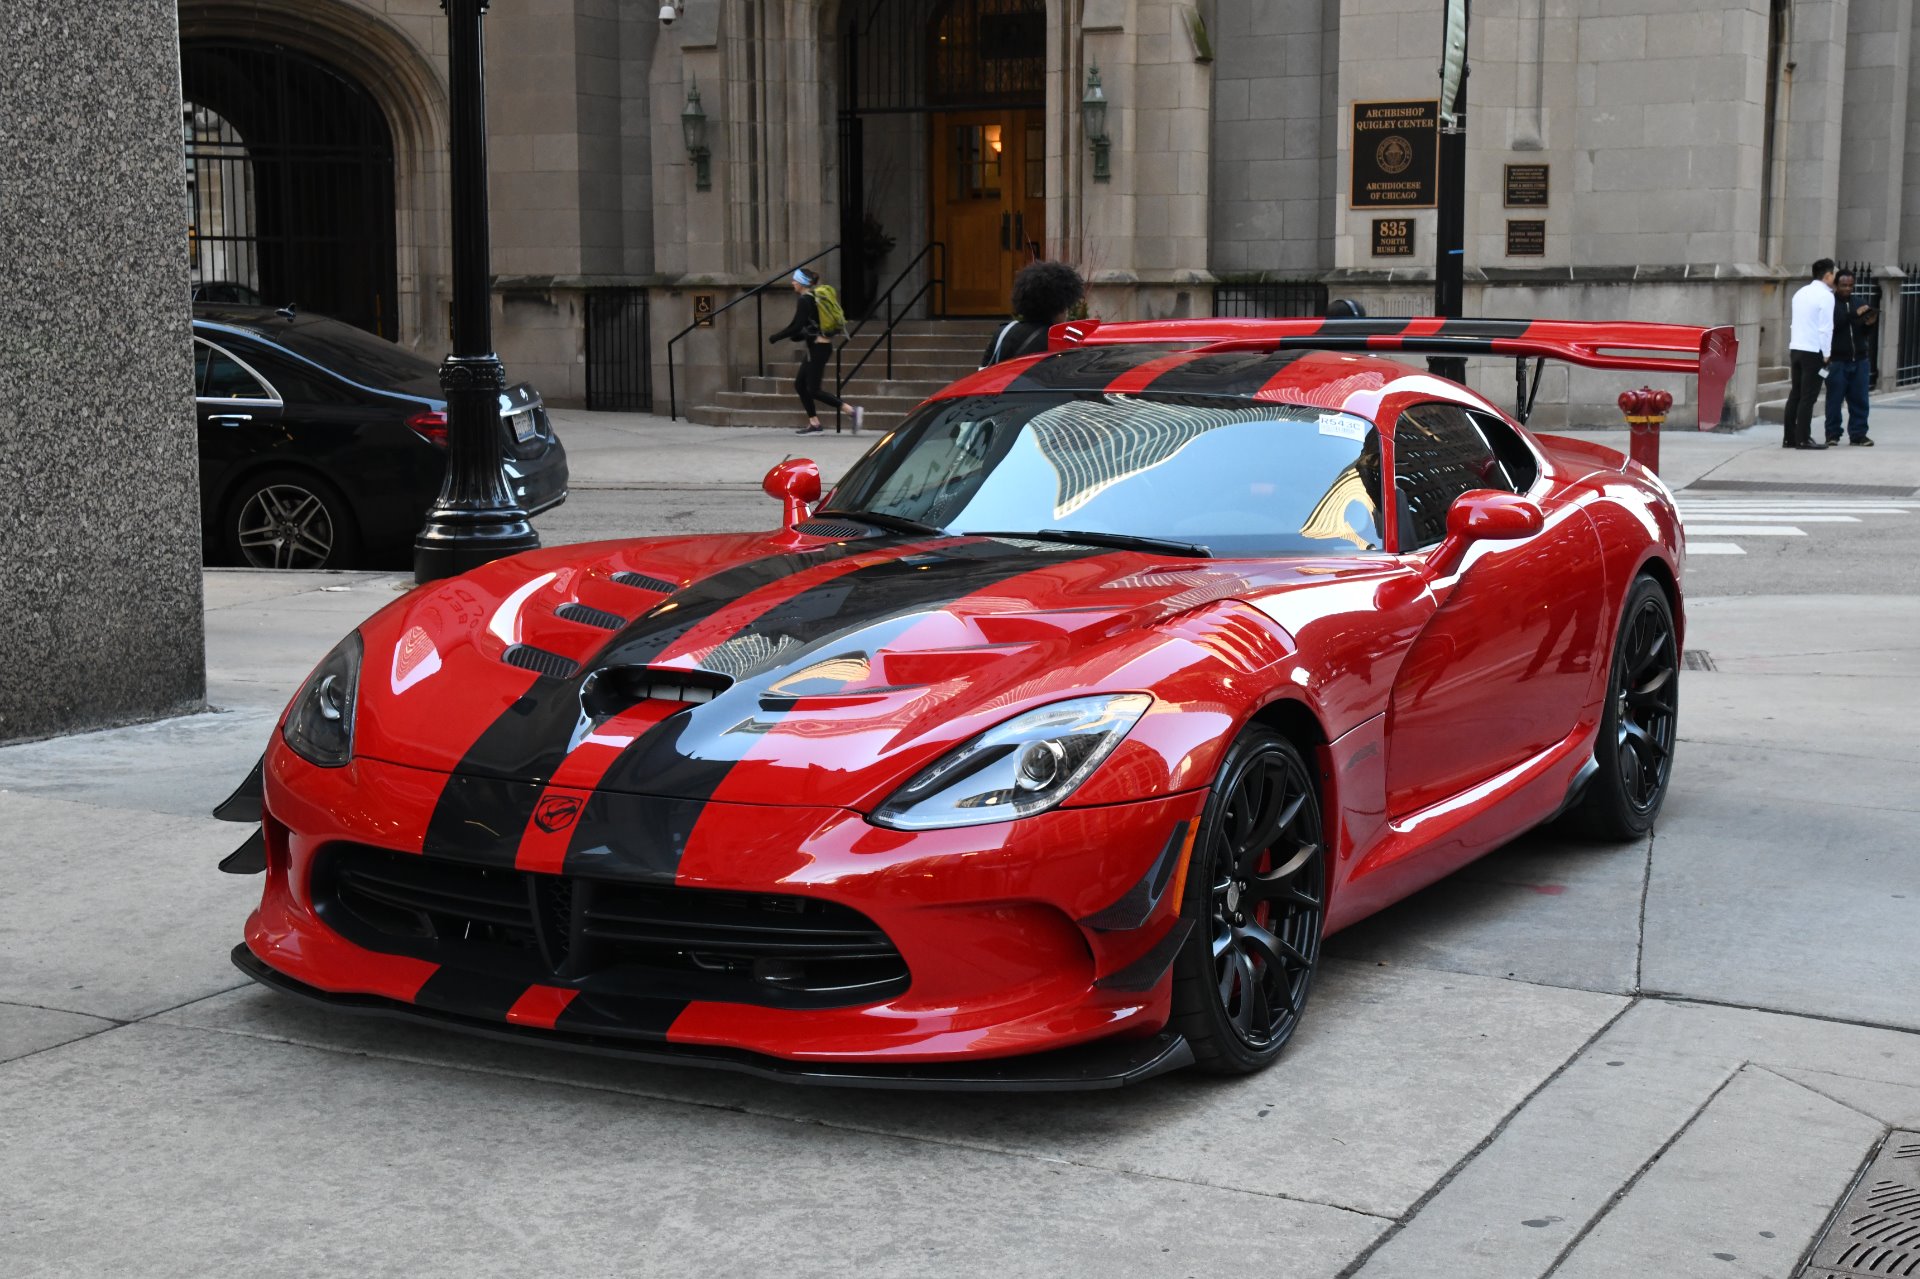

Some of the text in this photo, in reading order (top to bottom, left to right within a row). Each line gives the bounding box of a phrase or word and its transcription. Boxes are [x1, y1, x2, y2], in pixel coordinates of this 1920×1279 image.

[1366, 107, 1425, 118] ARCHBISHOP
[1356, 119, 1434, 131] QUIGLEY CENTER
[1366, 181, 1421, 190] ARCHDIOCESE
[1370, 191, 1417, 200] OF CHICAGO
[1380, 221, 1407, 236] 835
